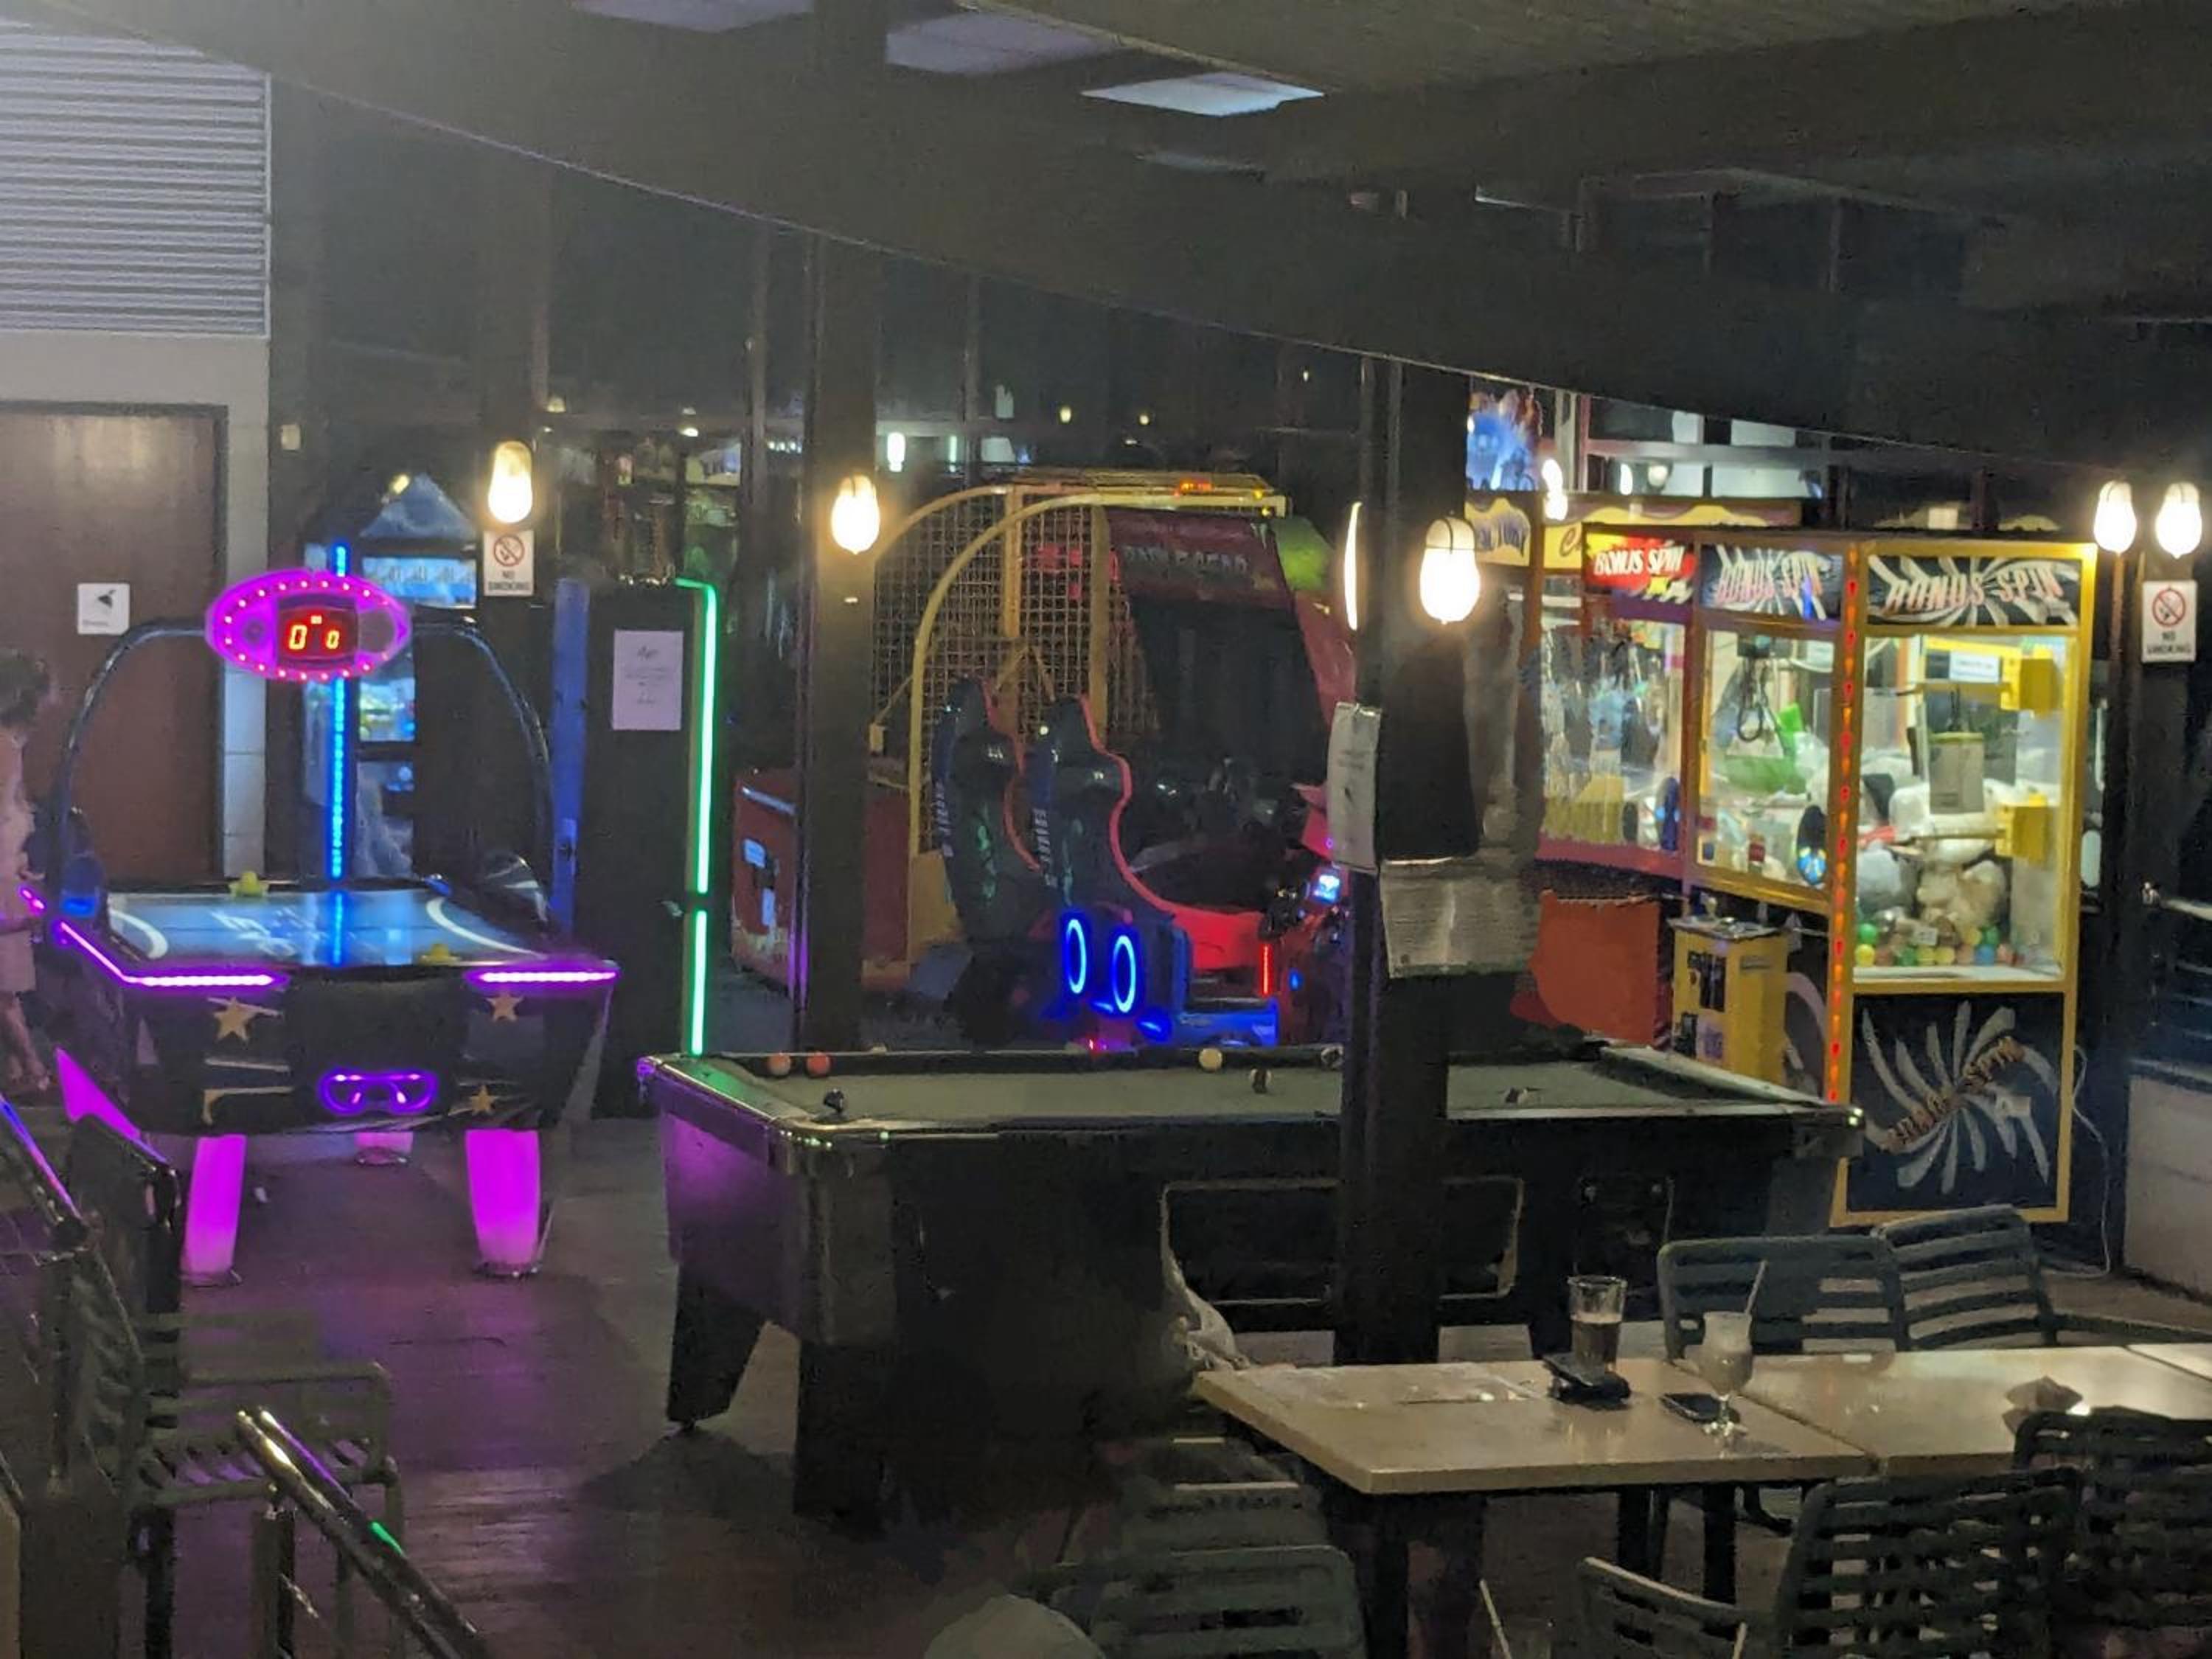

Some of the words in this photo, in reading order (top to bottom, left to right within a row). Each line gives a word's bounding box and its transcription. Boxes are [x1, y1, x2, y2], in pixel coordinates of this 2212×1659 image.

[1593, 549, 1644, 576] BONUS
[1881, 572, 1984, 617] BONUS
[1996, 565, 2064, 603] SPIN
[289, 625, 307, 650] 0
[326, 630, 340, 649] 0
